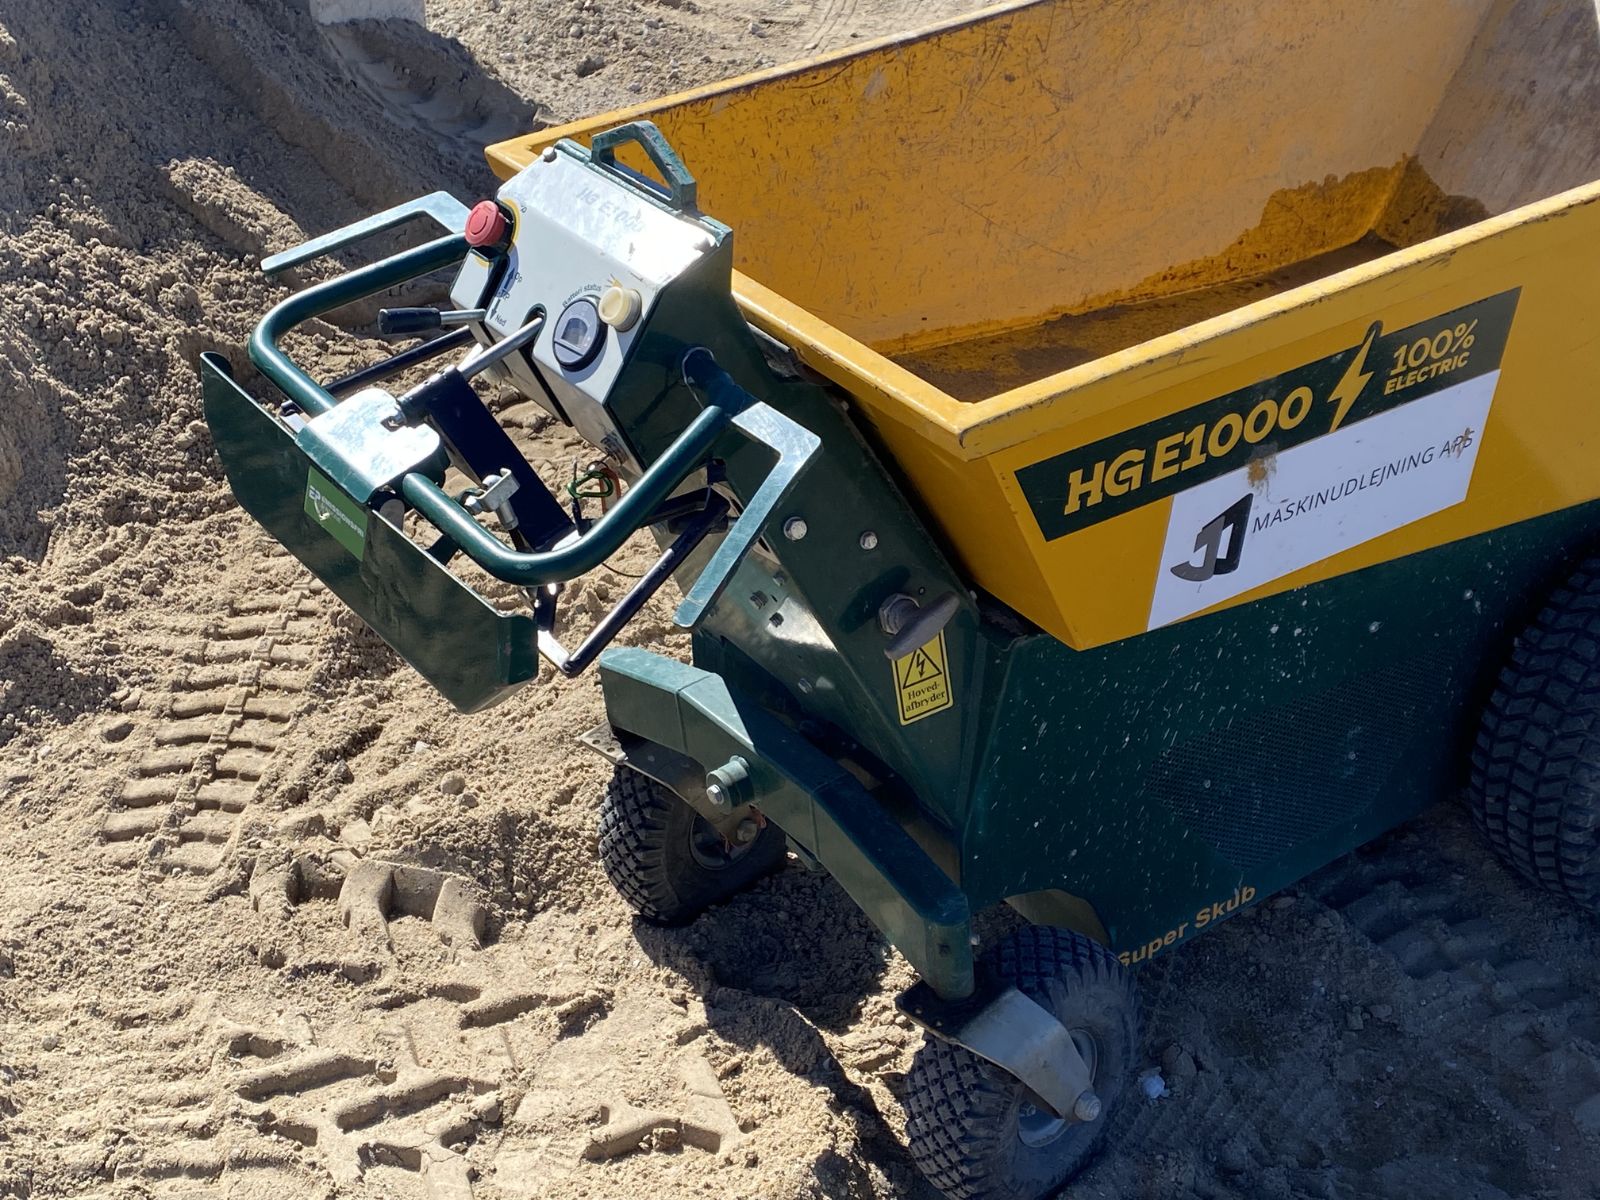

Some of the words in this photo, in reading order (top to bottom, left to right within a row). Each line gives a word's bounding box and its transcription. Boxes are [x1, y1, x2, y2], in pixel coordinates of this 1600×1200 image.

[1390, 318, 1478, 375] 100%
[1383, 351, 1470, 395] ELECTRIC
[1251, 448, 1434, 533] MASKINUDLEJNING
[905, 691, 946, 712] afbryder
[1195, 885, 1256, 929] Skub
